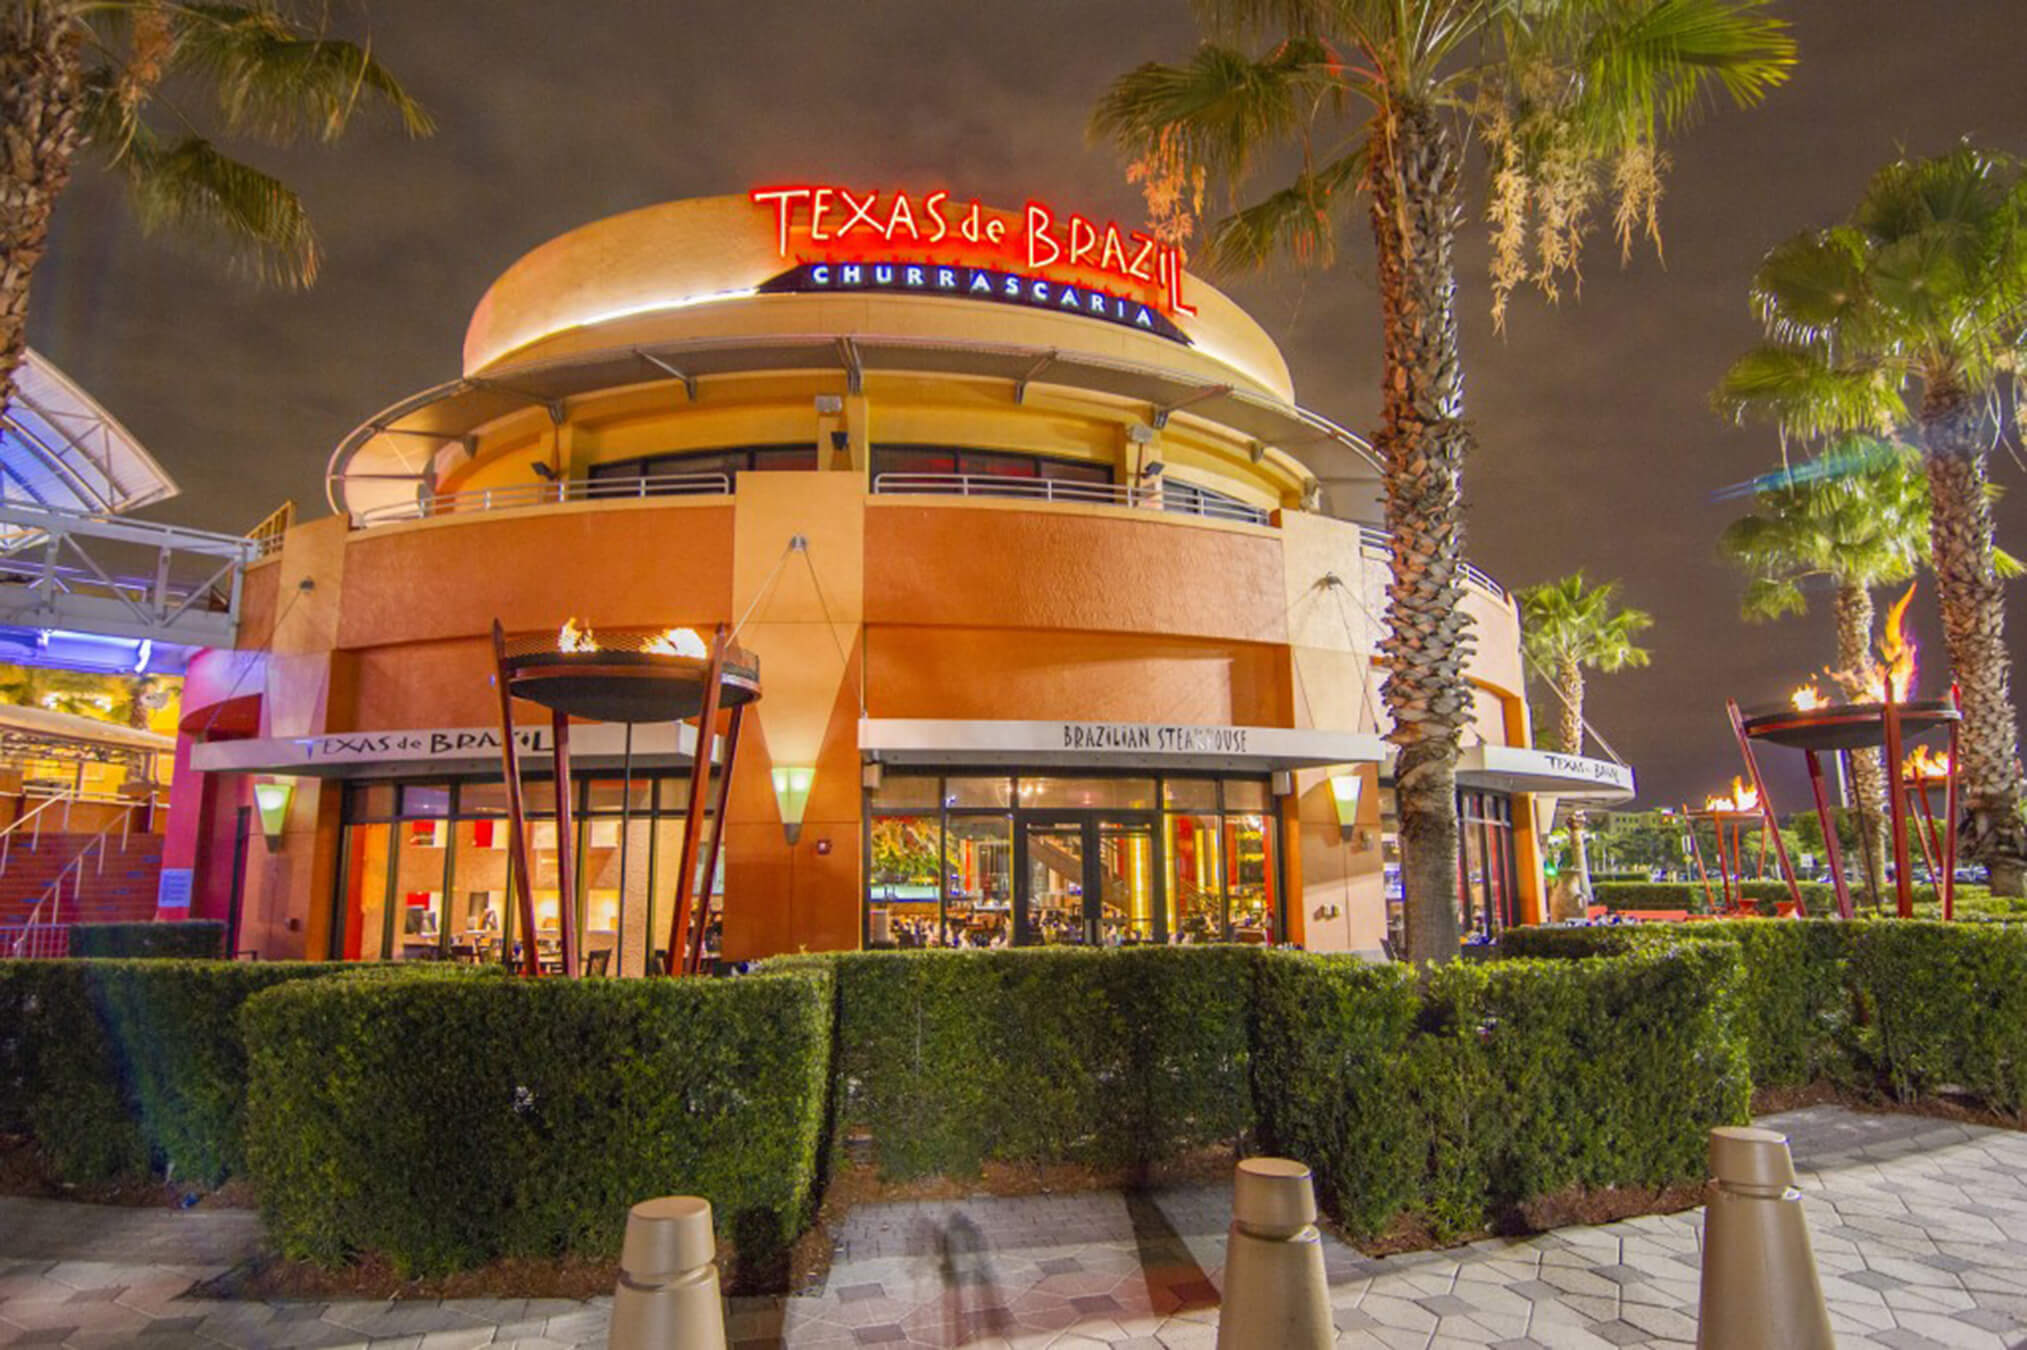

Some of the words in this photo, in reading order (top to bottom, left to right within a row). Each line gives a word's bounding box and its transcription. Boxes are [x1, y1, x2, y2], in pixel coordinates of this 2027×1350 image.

[752, 187, 948, 257] TEXAS
[960, 203, 1005, 243] de
[1026, 204, 1197, 319] BRAZIL
[811, 263, 1154, 326] CHURRASCARIA
[293, 735, 391, 760] TEXAS
[396, 735, 422, 748] de
[430, 731, 555, 754] BRAIL
[1063, 725, 1150, 748] BRAZILIAN
